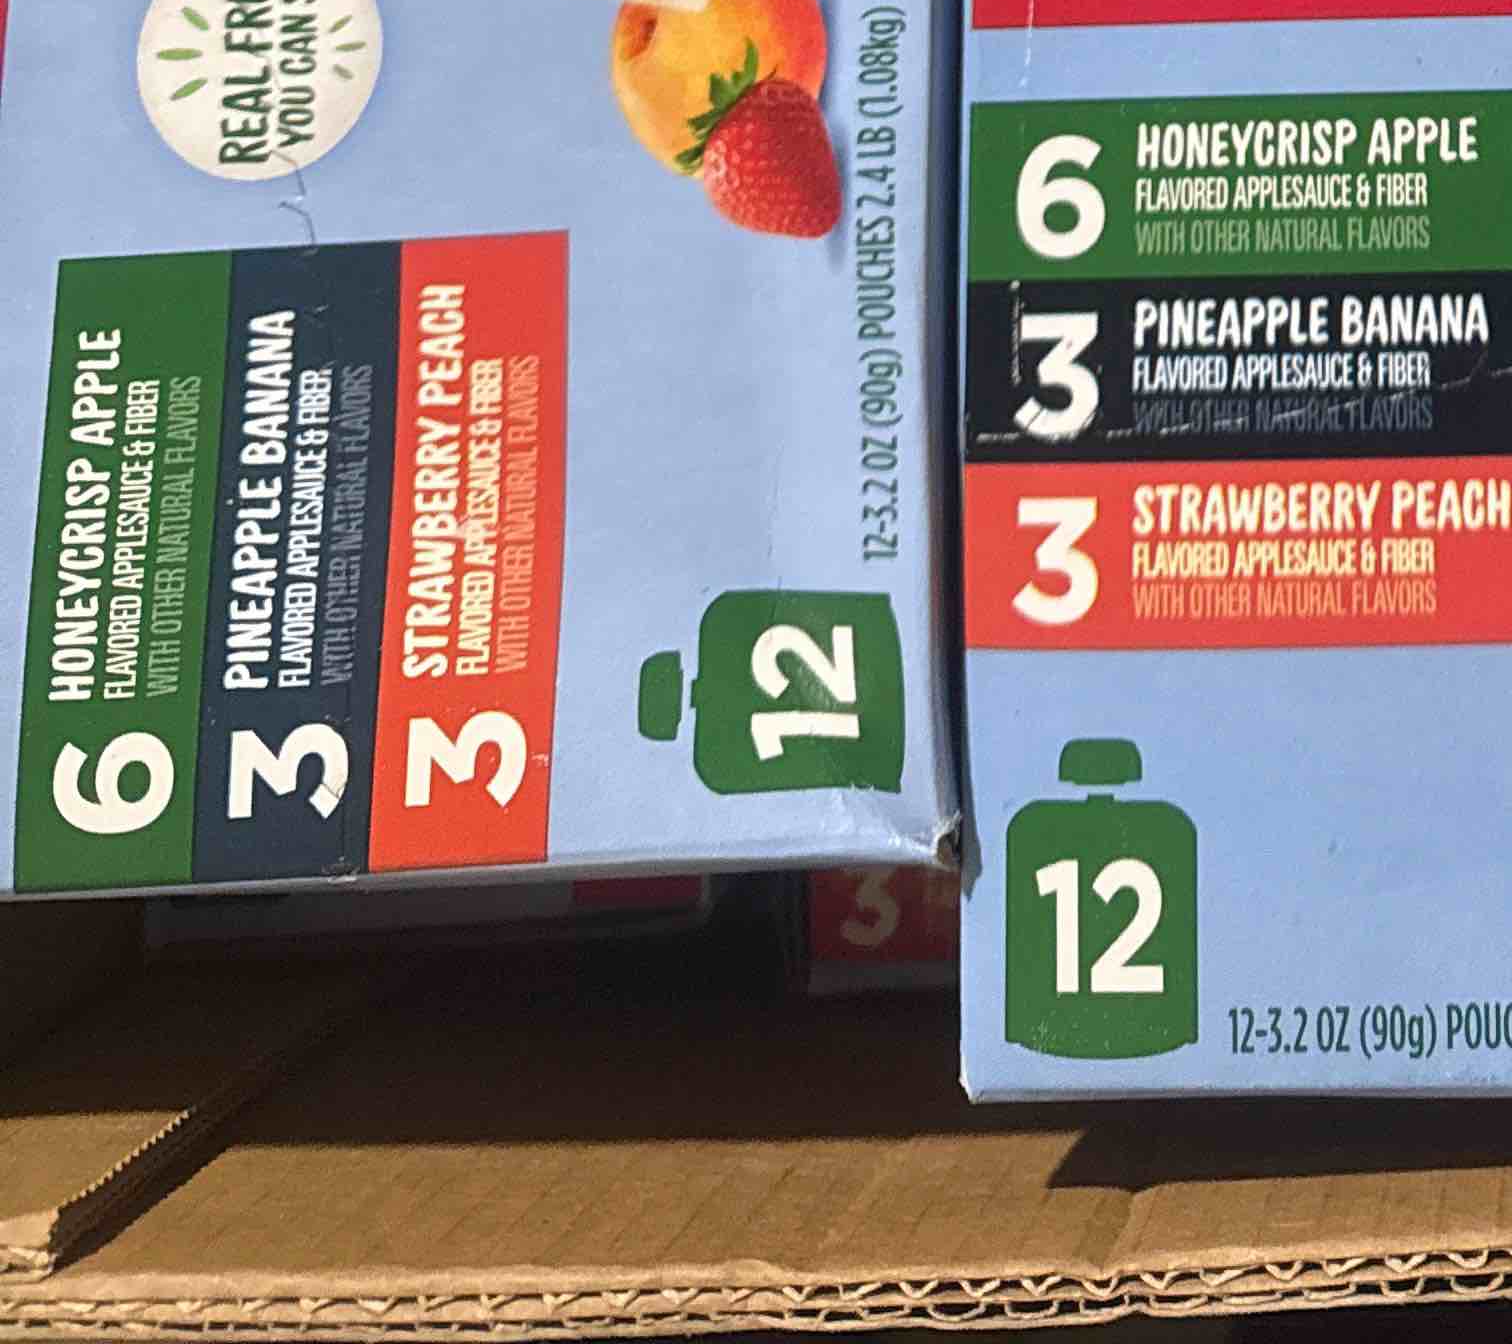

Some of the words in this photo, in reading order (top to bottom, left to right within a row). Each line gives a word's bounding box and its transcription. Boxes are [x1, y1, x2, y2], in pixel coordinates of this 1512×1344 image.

[278, 13, 318, 76] CAN
[858, 5, 907, 118] (1.08kg)
[218, 64, 273, 164] REAL
[276, 84, 316, 149] YOU
[856, 125, 897, 159] LB
[1136, 119, 1358, 170] HONEYCRISP
[1367, 117, 1479, 164] APPLE
[855, 167, 896, 209] 2.4
[1015, 135, 1107, 260] 6
[1135, 176, 1229, 213] FLAVORED
[1232, 174, 1351, 211] APPLESAUCE
[1356, 173, 1370, 208] &
[1375, 171, 1429, 207] FIBER
[1135, 220, 1186, 256] WITH
[1189, 219, 1250, 255] OTHER
[1254, 217, 1344, 253] NATURAL
[1347, 215, 1431, 251] FLAVORS
[855, 214, 897, 340] POUCHES
[1133, 296, 1330, 348] PINEAPPLE
[1341, 293, 1490, 344] BANANA
[70, 328, 122, 446] APPLE
[240, 309, 296, 465] BANANA
[416, 283, 467, 407] PEACH
[858, 347, 903, 427] (90g)
[1014, 311, 1101, 440] 3
[1132, 356, 1229, 392] FLAVORED
[1230, 354, 1354, 390] APPLESAUCE
[1357, 352, 1372, 387] &
[1378, 351, 1431, 387] FIBER
[124, 379, 161, 436] FIBER
[295, 427, 331, 447] &
[296, 366, 334, 426] FIBER
[122, 439, 157, 457] &
[860, 434, 899, 472] OZ
[112, 460, 155, 589] APPLESAUCE
[284, 448, 328, 579] APPLESAUCE
[402, 416, 464, 679] STRAWBERRY
[861, 478, 900, 563] 12-3.2
[1132, 481, 1378, 536] STRAWBERRY
[1390, 479, 1512, 532] PEACH
[48, 458, 112, 702] HONEYCRISP
[223, 475, 283, 690] PINEAPPLE
[1012, 495, 1100, 627] 3
[1132, 544, 1229, 580] FLAVORED
[1232, 542, 1357, 579] APPLESAUCE
[1360, 540, 1375, 575] &
[1381, 538, 1435, 575] FIBER
[103, 593, 143, 701] FLAVORED
[278, 581, 318, 688] FLAVORED
[750, 622, 860, 762] 12
[52, 731, 176, 835] 6
[227, 722, 350, 820] 3
[403, 710, 528, 809] 3
[1034, 857, 1166, 995] 12
[1228, 1005, 1309, 1054] 12-3.2
[1316, 1005, 1351, 1053] OZ
[1359, 1003, 1438, 1060] (90g)
